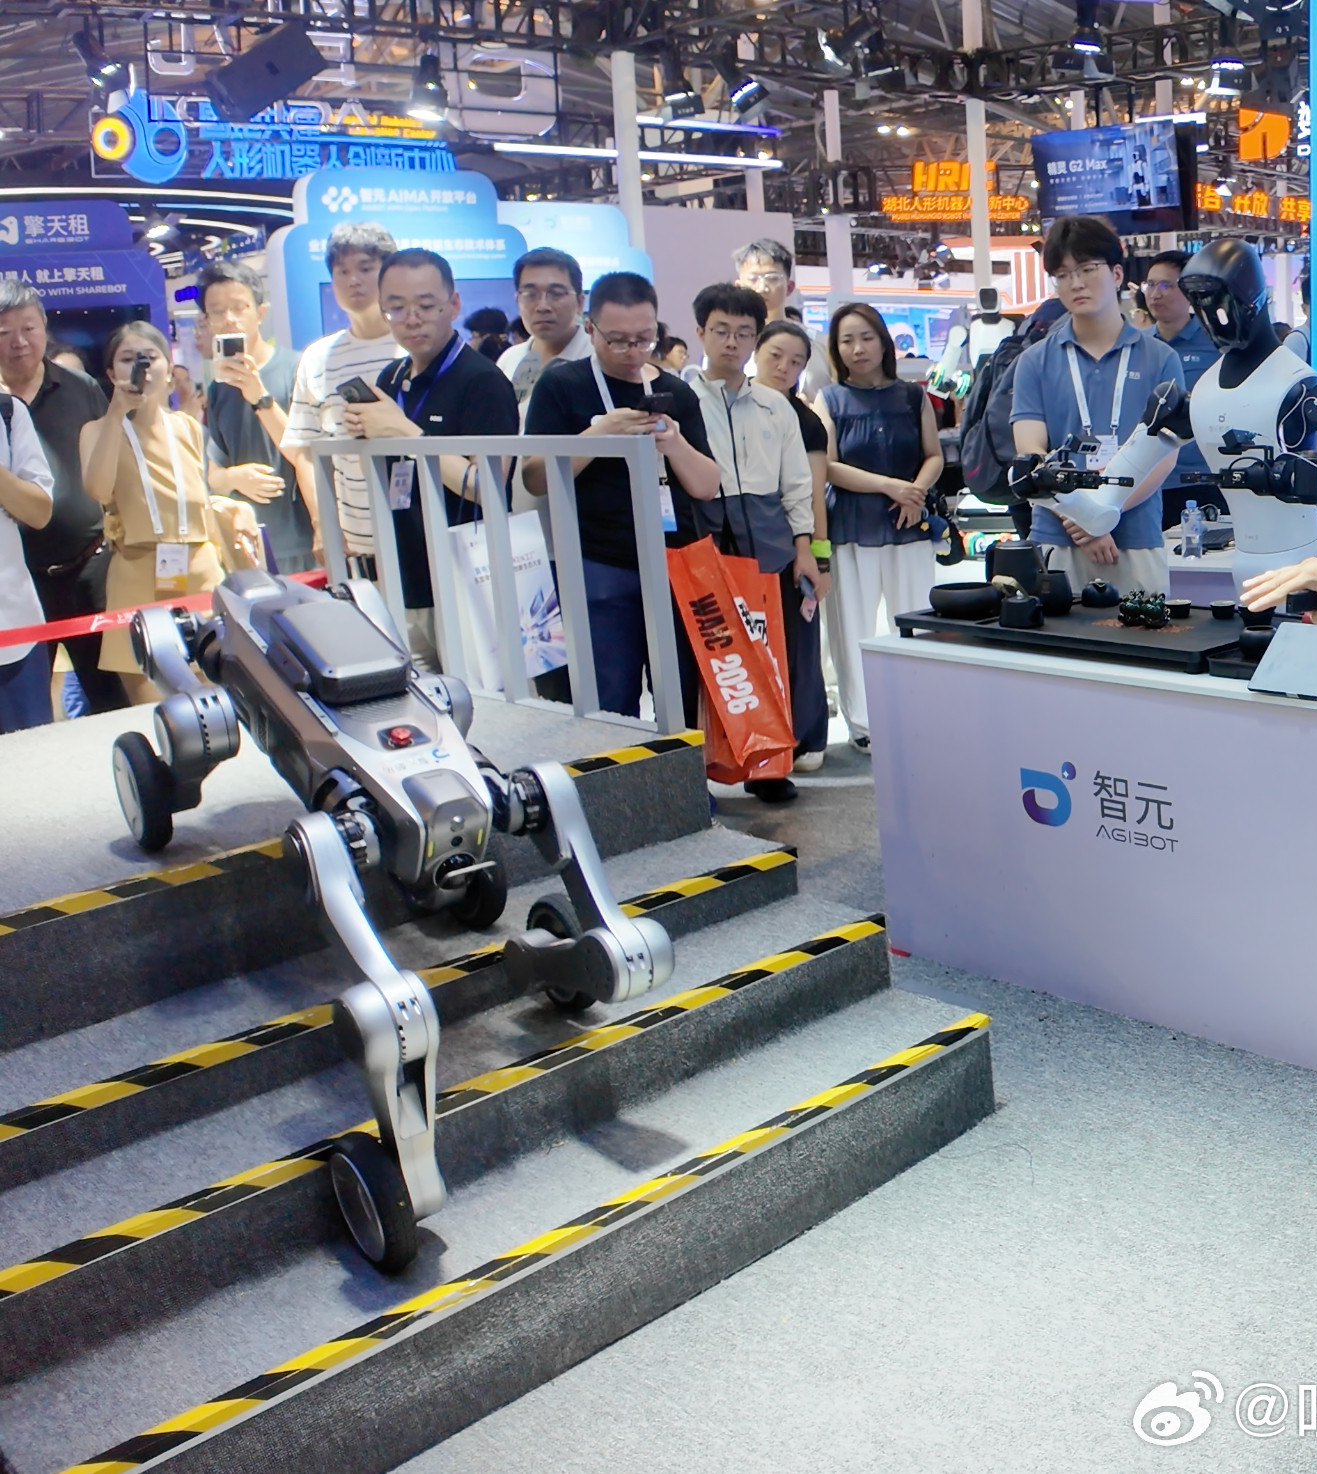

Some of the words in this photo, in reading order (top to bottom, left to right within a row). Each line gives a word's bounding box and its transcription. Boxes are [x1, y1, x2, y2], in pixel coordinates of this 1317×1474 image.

[1069, 160, 1084, 173] G2
[1086, 158, 1108, 171] Max
[882, 195, 1030, 213] 湖北人形机器人新中心
[24, 213, 90, 237] 擎天租
[36, 267, 104, 285] 就上擎天租
[48, 286, 74, 297] WITH
[76, 284, 127, 295] SHAREBOT
[711, 653, 760, 715] 2026
[1094, 770, 1174, 831] 智元
[1096, 824, 1179, 853] AGIBOT
